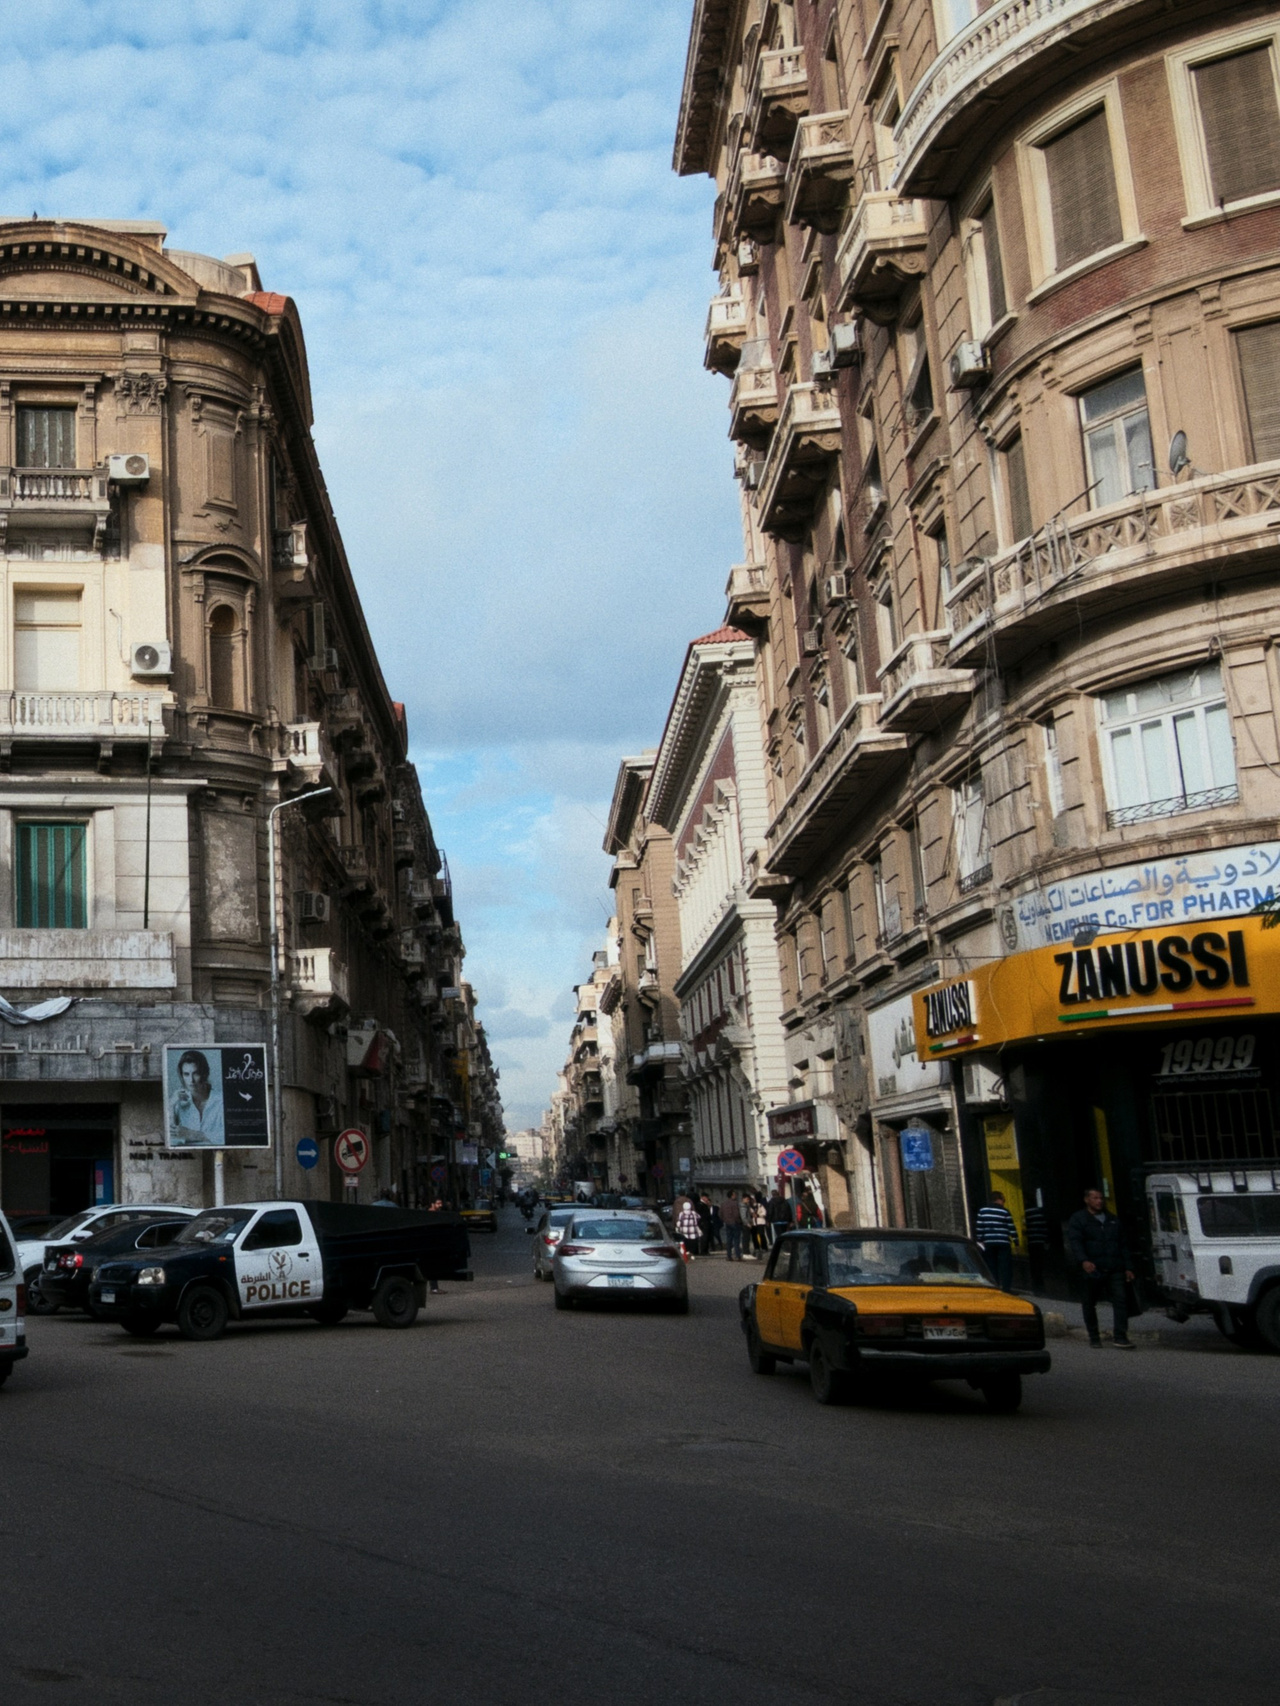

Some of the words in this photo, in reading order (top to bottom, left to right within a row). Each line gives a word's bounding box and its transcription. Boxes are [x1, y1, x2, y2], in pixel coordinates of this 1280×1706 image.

[1069, 867, 1174, 908] والصناعات
[1132, 900, 1174, 922] FOR
[1183, 885, 1278, 915] PHARM
[1054, 930, 1249, 1003] ZANUSSI
[923, 980, 977, 1036] ZANUSSI
[1160, 1033, 1257, 1076] 19999
[241, 1272, 271, 1284] الشرطة
[246, 1280, 311, 1303] POLICE
